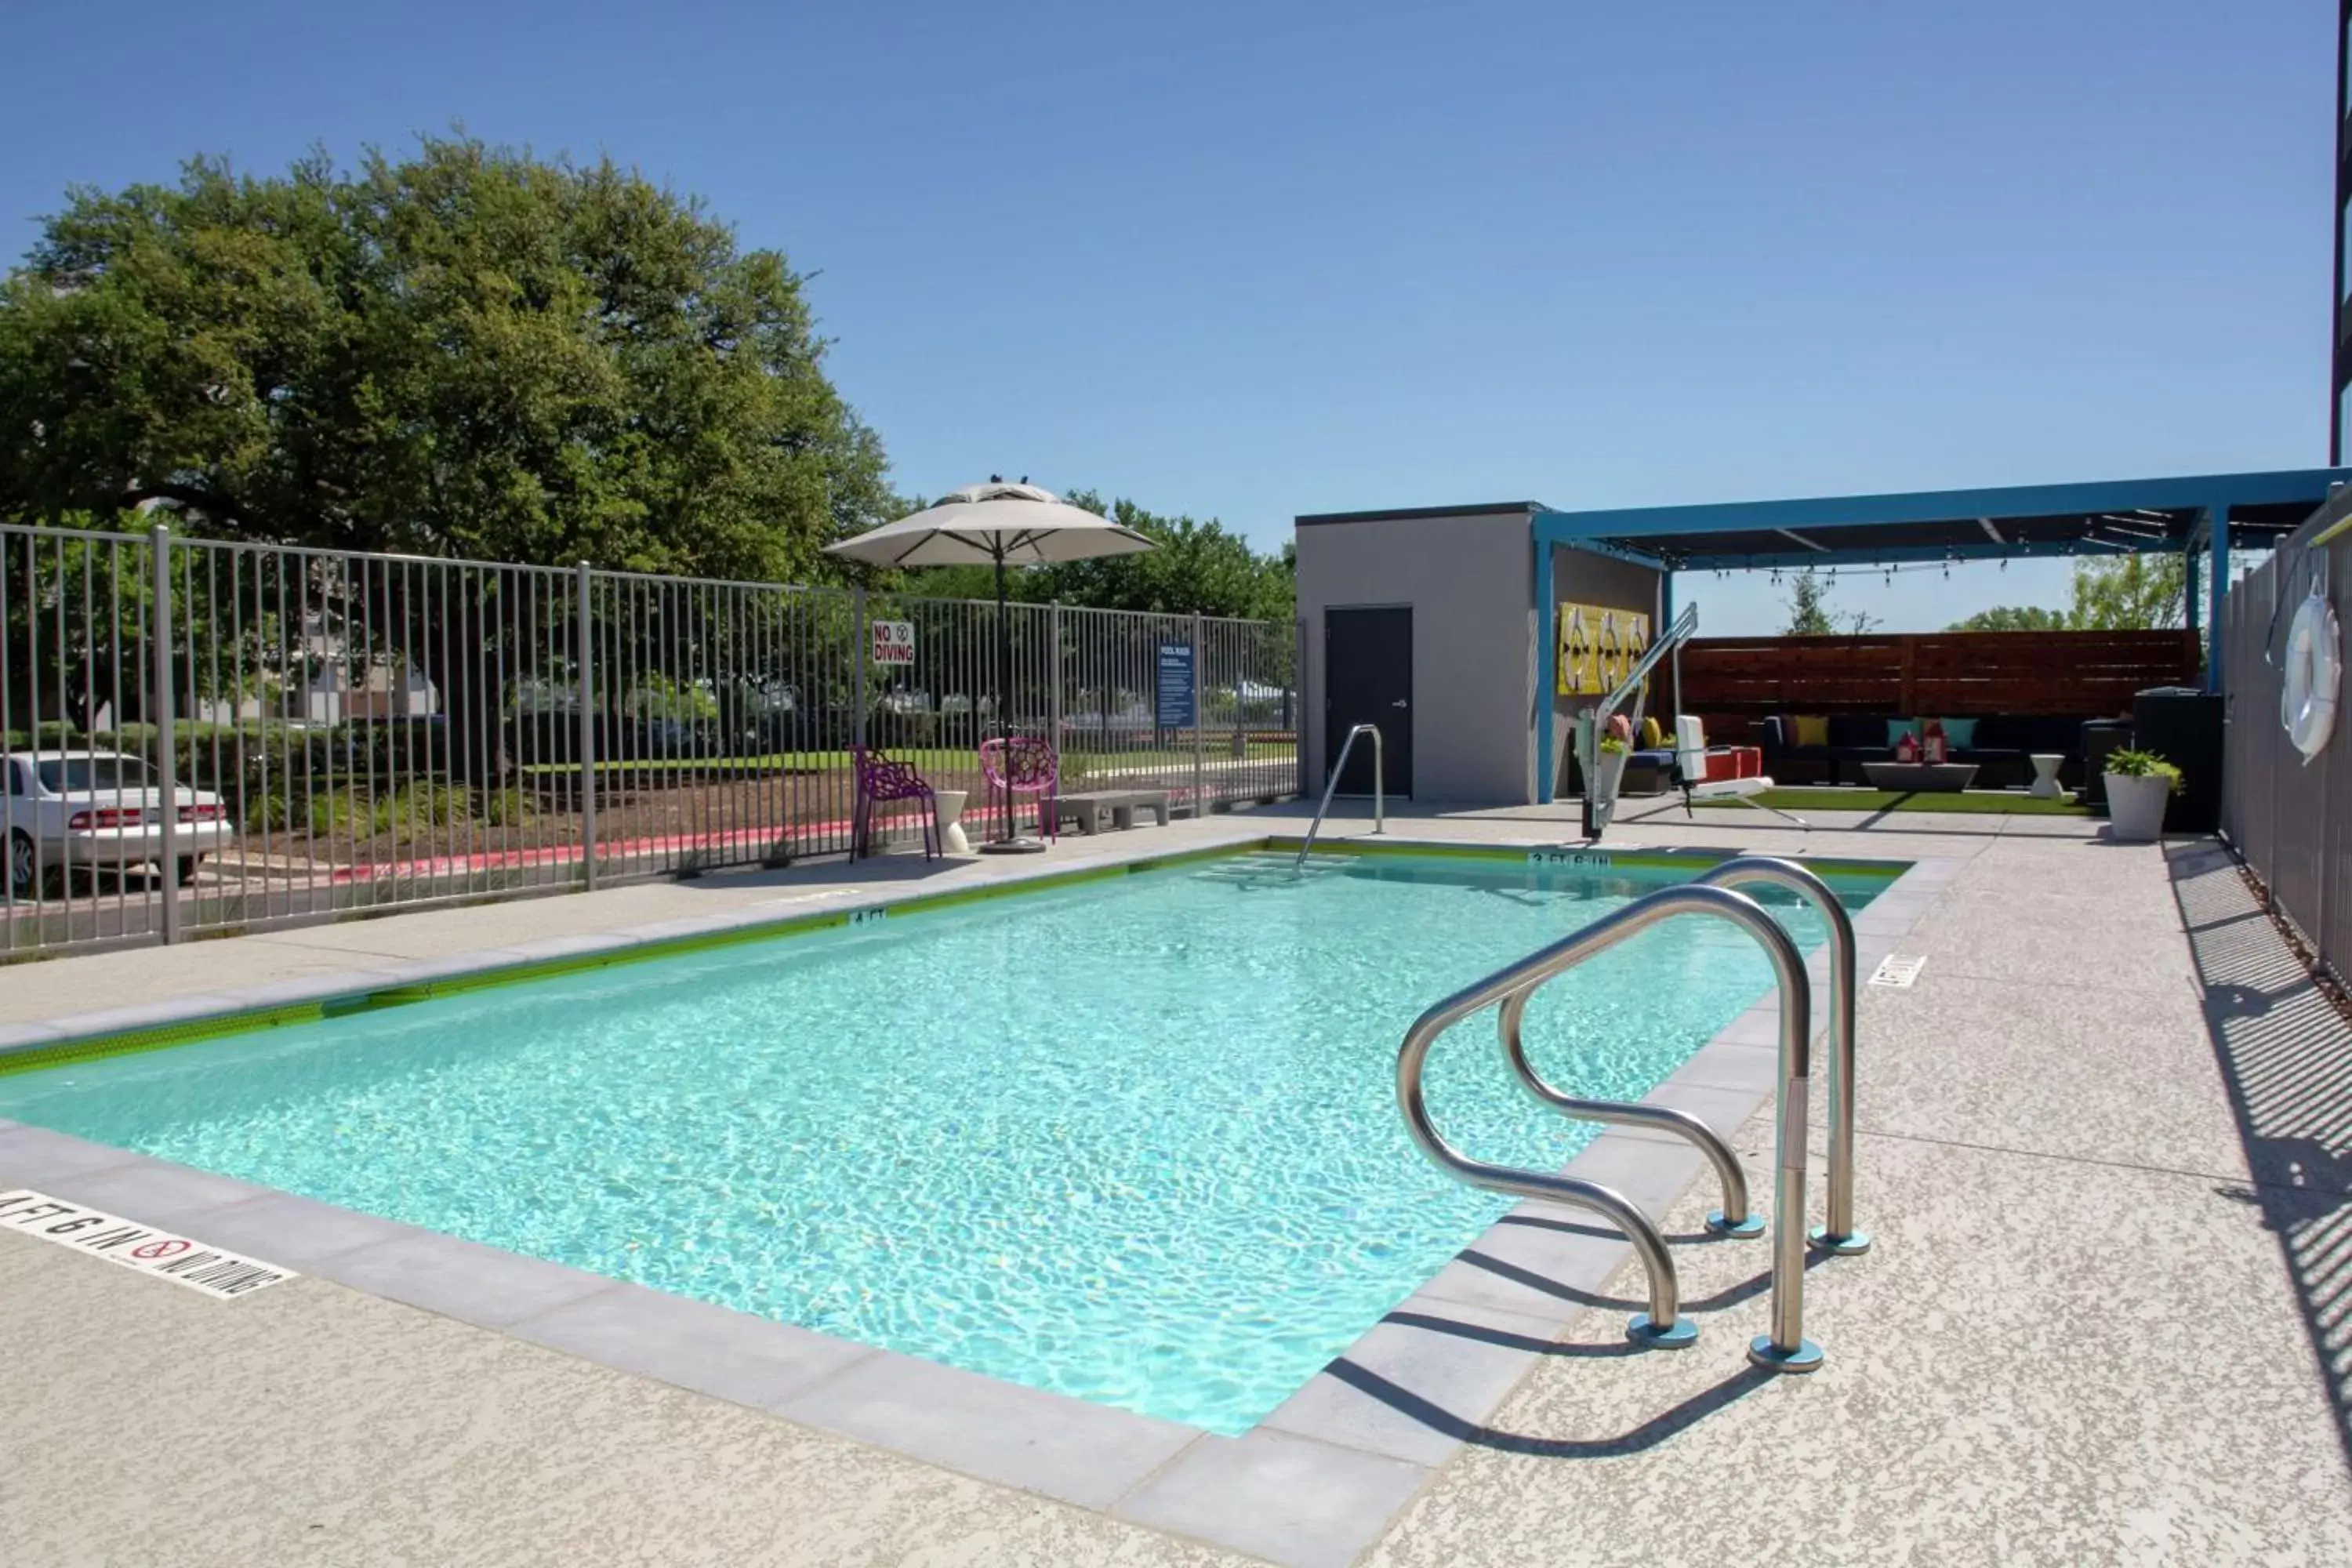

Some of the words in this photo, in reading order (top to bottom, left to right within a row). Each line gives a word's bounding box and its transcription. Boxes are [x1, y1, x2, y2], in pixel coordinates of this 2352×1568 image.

[874, 625, 891, 641] NO
[875, 644, 913, 662] DIVING
[869, 908, 884, 921] FT
[0, 1203, 77, 1225] FT
[45, 1217, 105, 1234] 6
[74, 1225, 154, 1250] IN
[152, 1250, 223, 1274] NO
[180, 1260, 283, 1294] DIVING
